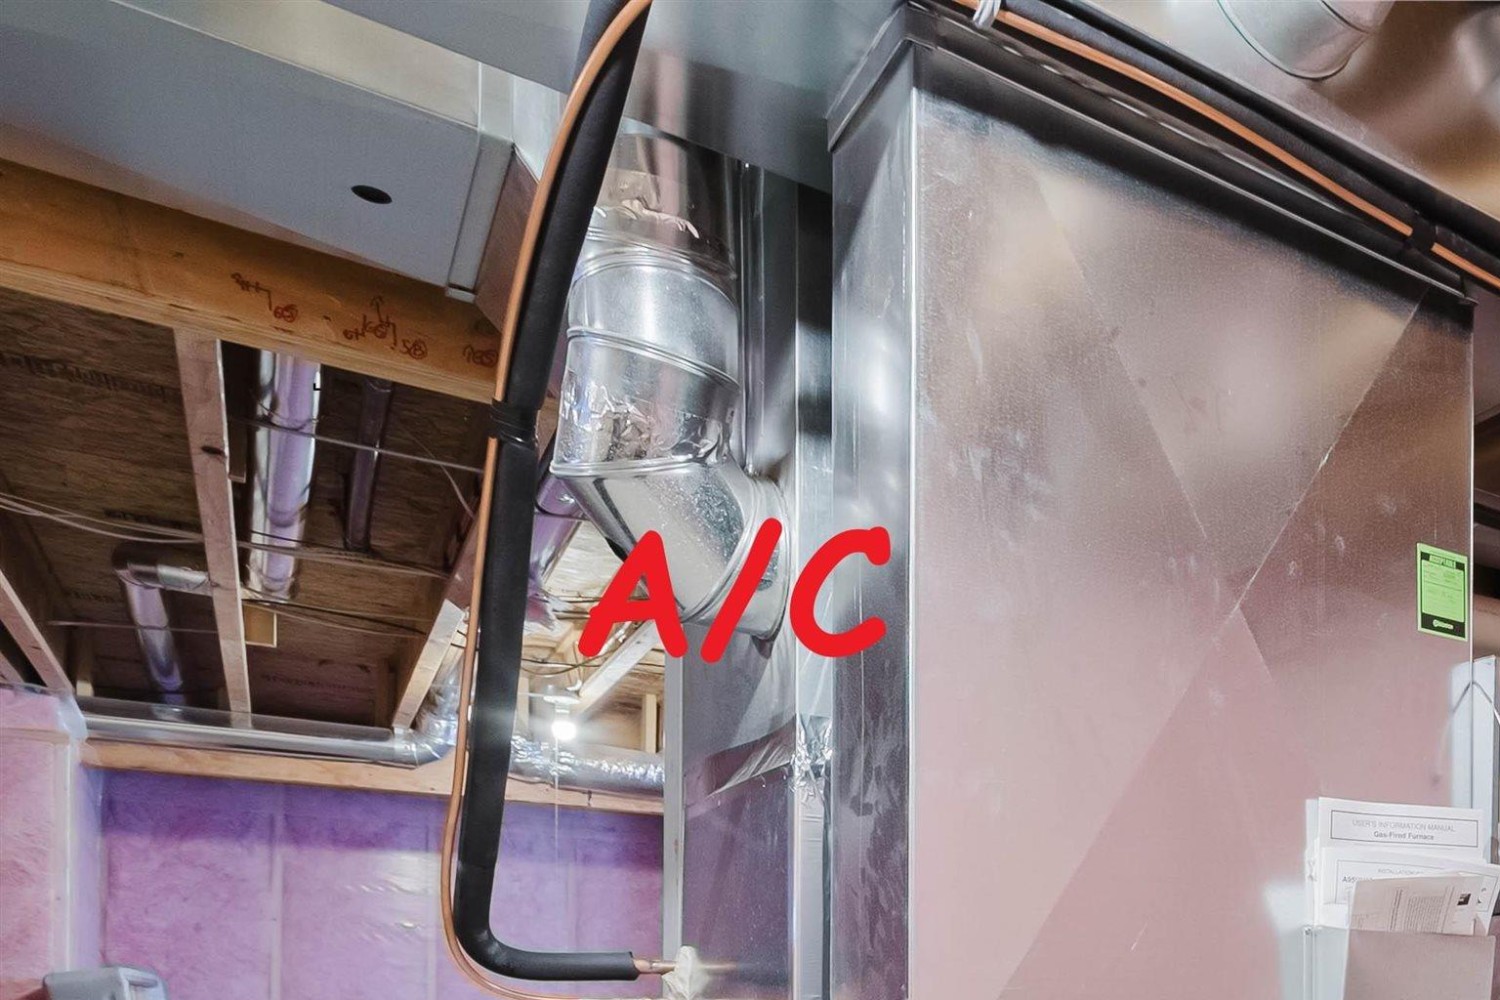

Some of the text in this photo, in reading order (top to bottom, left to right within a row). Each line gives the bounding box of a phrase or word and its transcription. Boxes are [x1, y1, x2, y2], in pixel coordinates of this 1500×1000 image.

[1378, 820, 1427, 831] INFORMATION
[1427, 822, 1456, 832] MANUAL
[1408, 832, 1434, 840] Furnace
